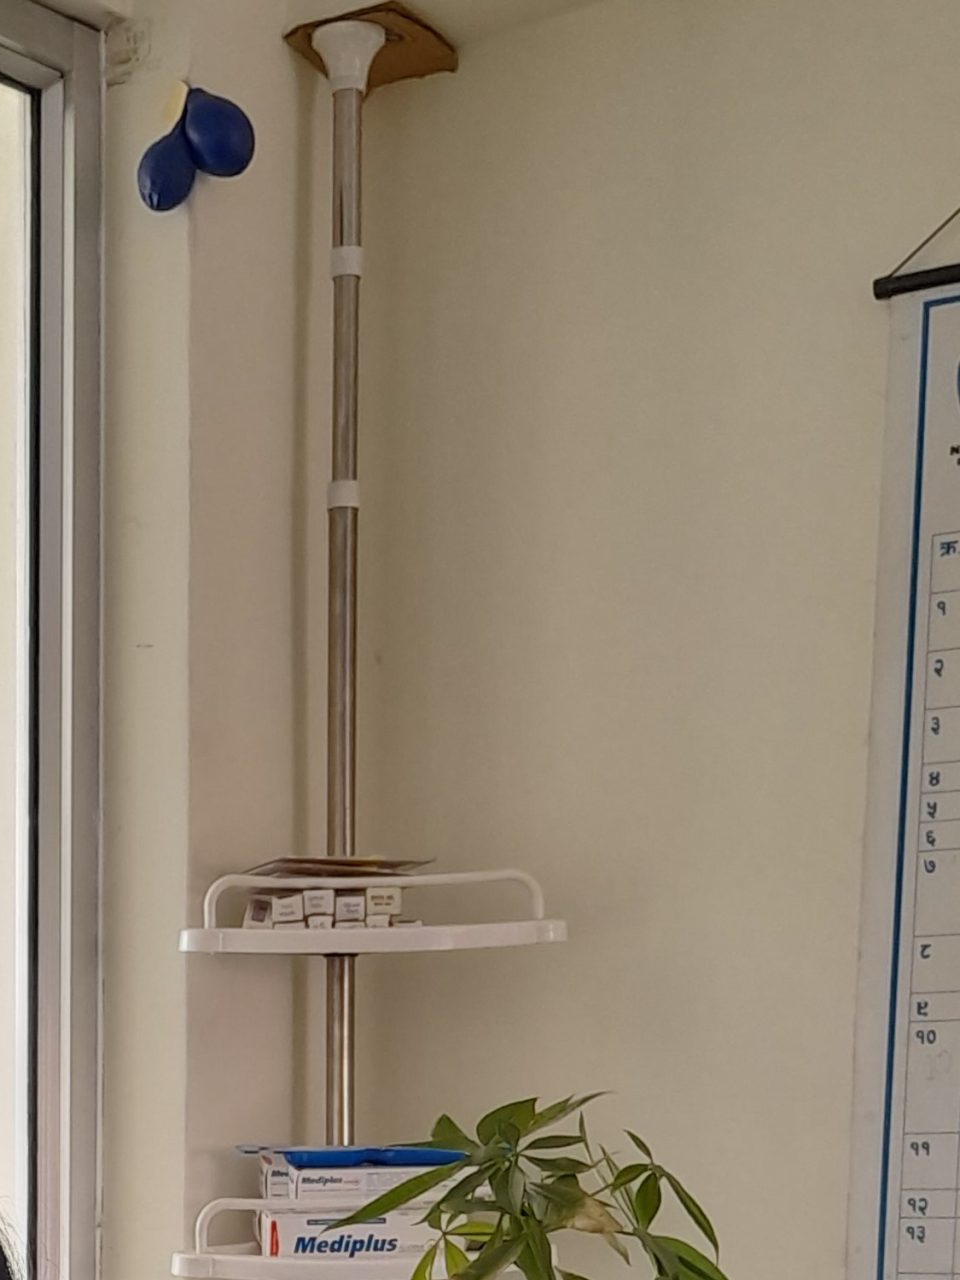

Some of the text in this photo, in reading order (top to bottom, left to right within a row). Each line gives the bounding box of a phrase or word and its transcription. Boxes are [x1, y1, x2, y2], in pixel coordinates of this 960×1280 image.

[937, 601, 945, 616] १
[934, 659, 944, 677] २
[931, 716, 940, 735] ३
[929, 771, 940, 786] ४
[926, 830, 936, 847] ६
[924, 859, 936, 873] ७
[916, 1030, 936, 1044] १०
[910, 1142, 930, 1156] ११
[907, 1198, 928, 1216] १२
[906, 1226, 925, 1243] १३
[293, 1234, 398, 1258] Mediplus
